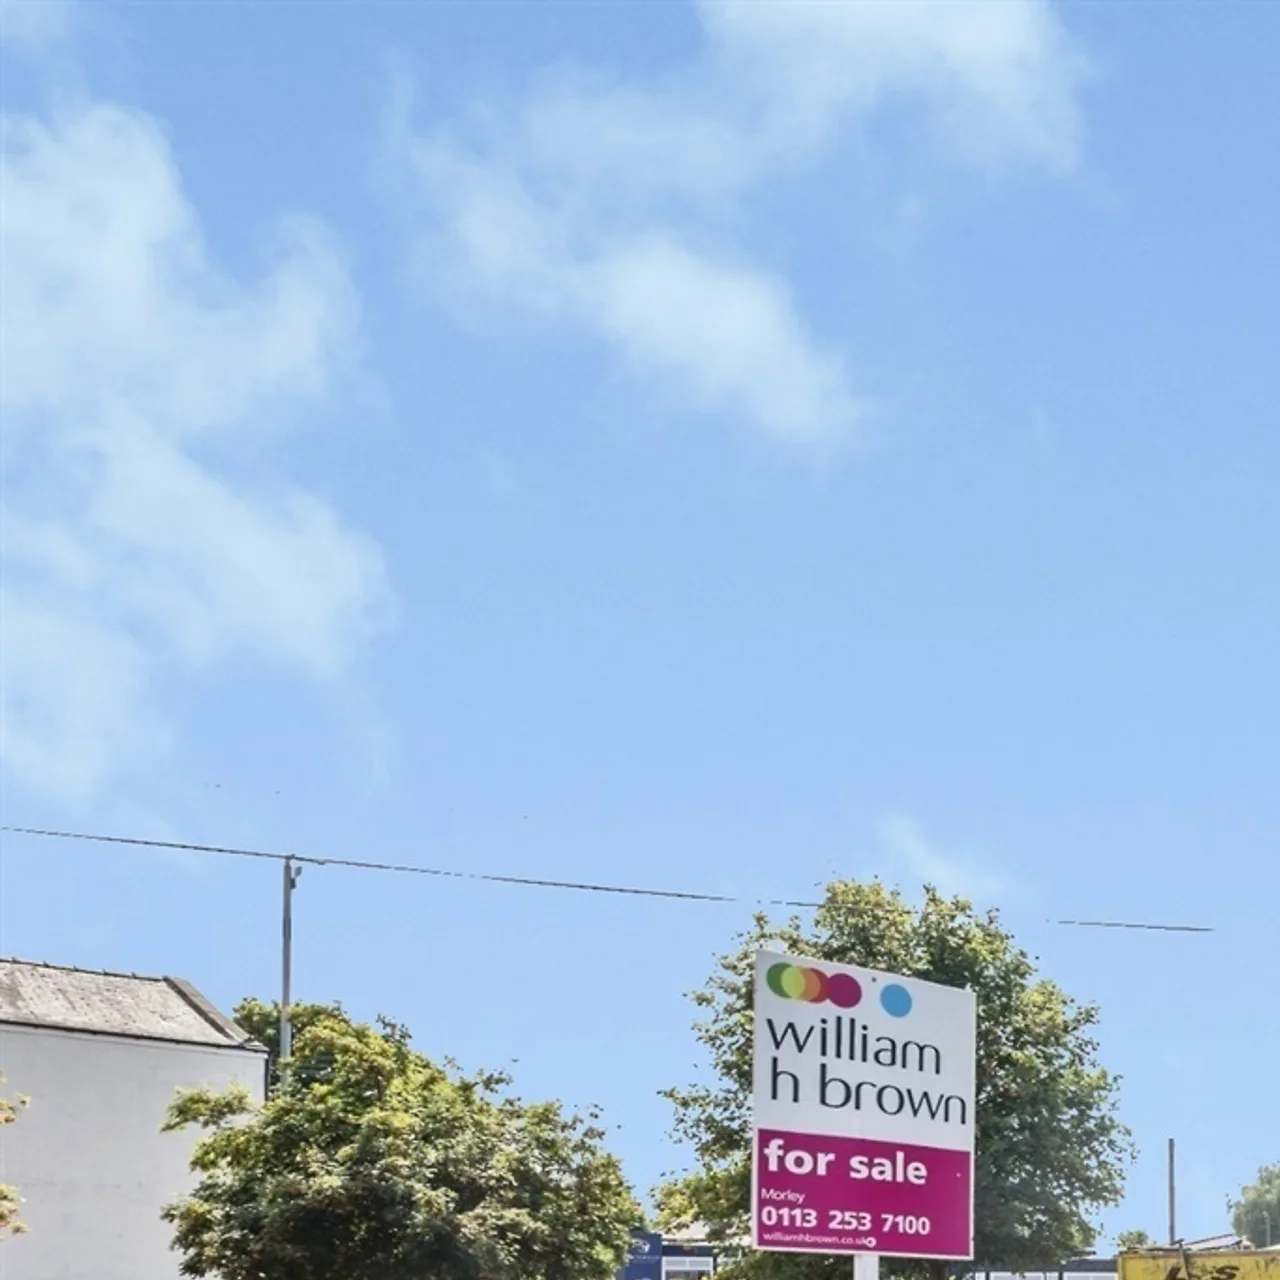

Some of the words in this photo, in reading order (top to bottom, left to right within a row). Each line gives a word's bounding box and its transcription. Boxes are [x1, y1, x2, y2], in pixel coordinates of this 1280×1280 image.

[766, 1016, 941, 1075] william
[771, 1057, 799, 1103] h
[820, 1063, 967, 1125] brown
[764, 1139, 835, 1176] for
[850, 1151, 928, 1185] sale
[761, 1188, 806, 1204] Morley
[761, 1206, 818, 1228] 0113
[828, 1210, 872, 1231] 253
[881, 1214, 931, 1235] 7100
